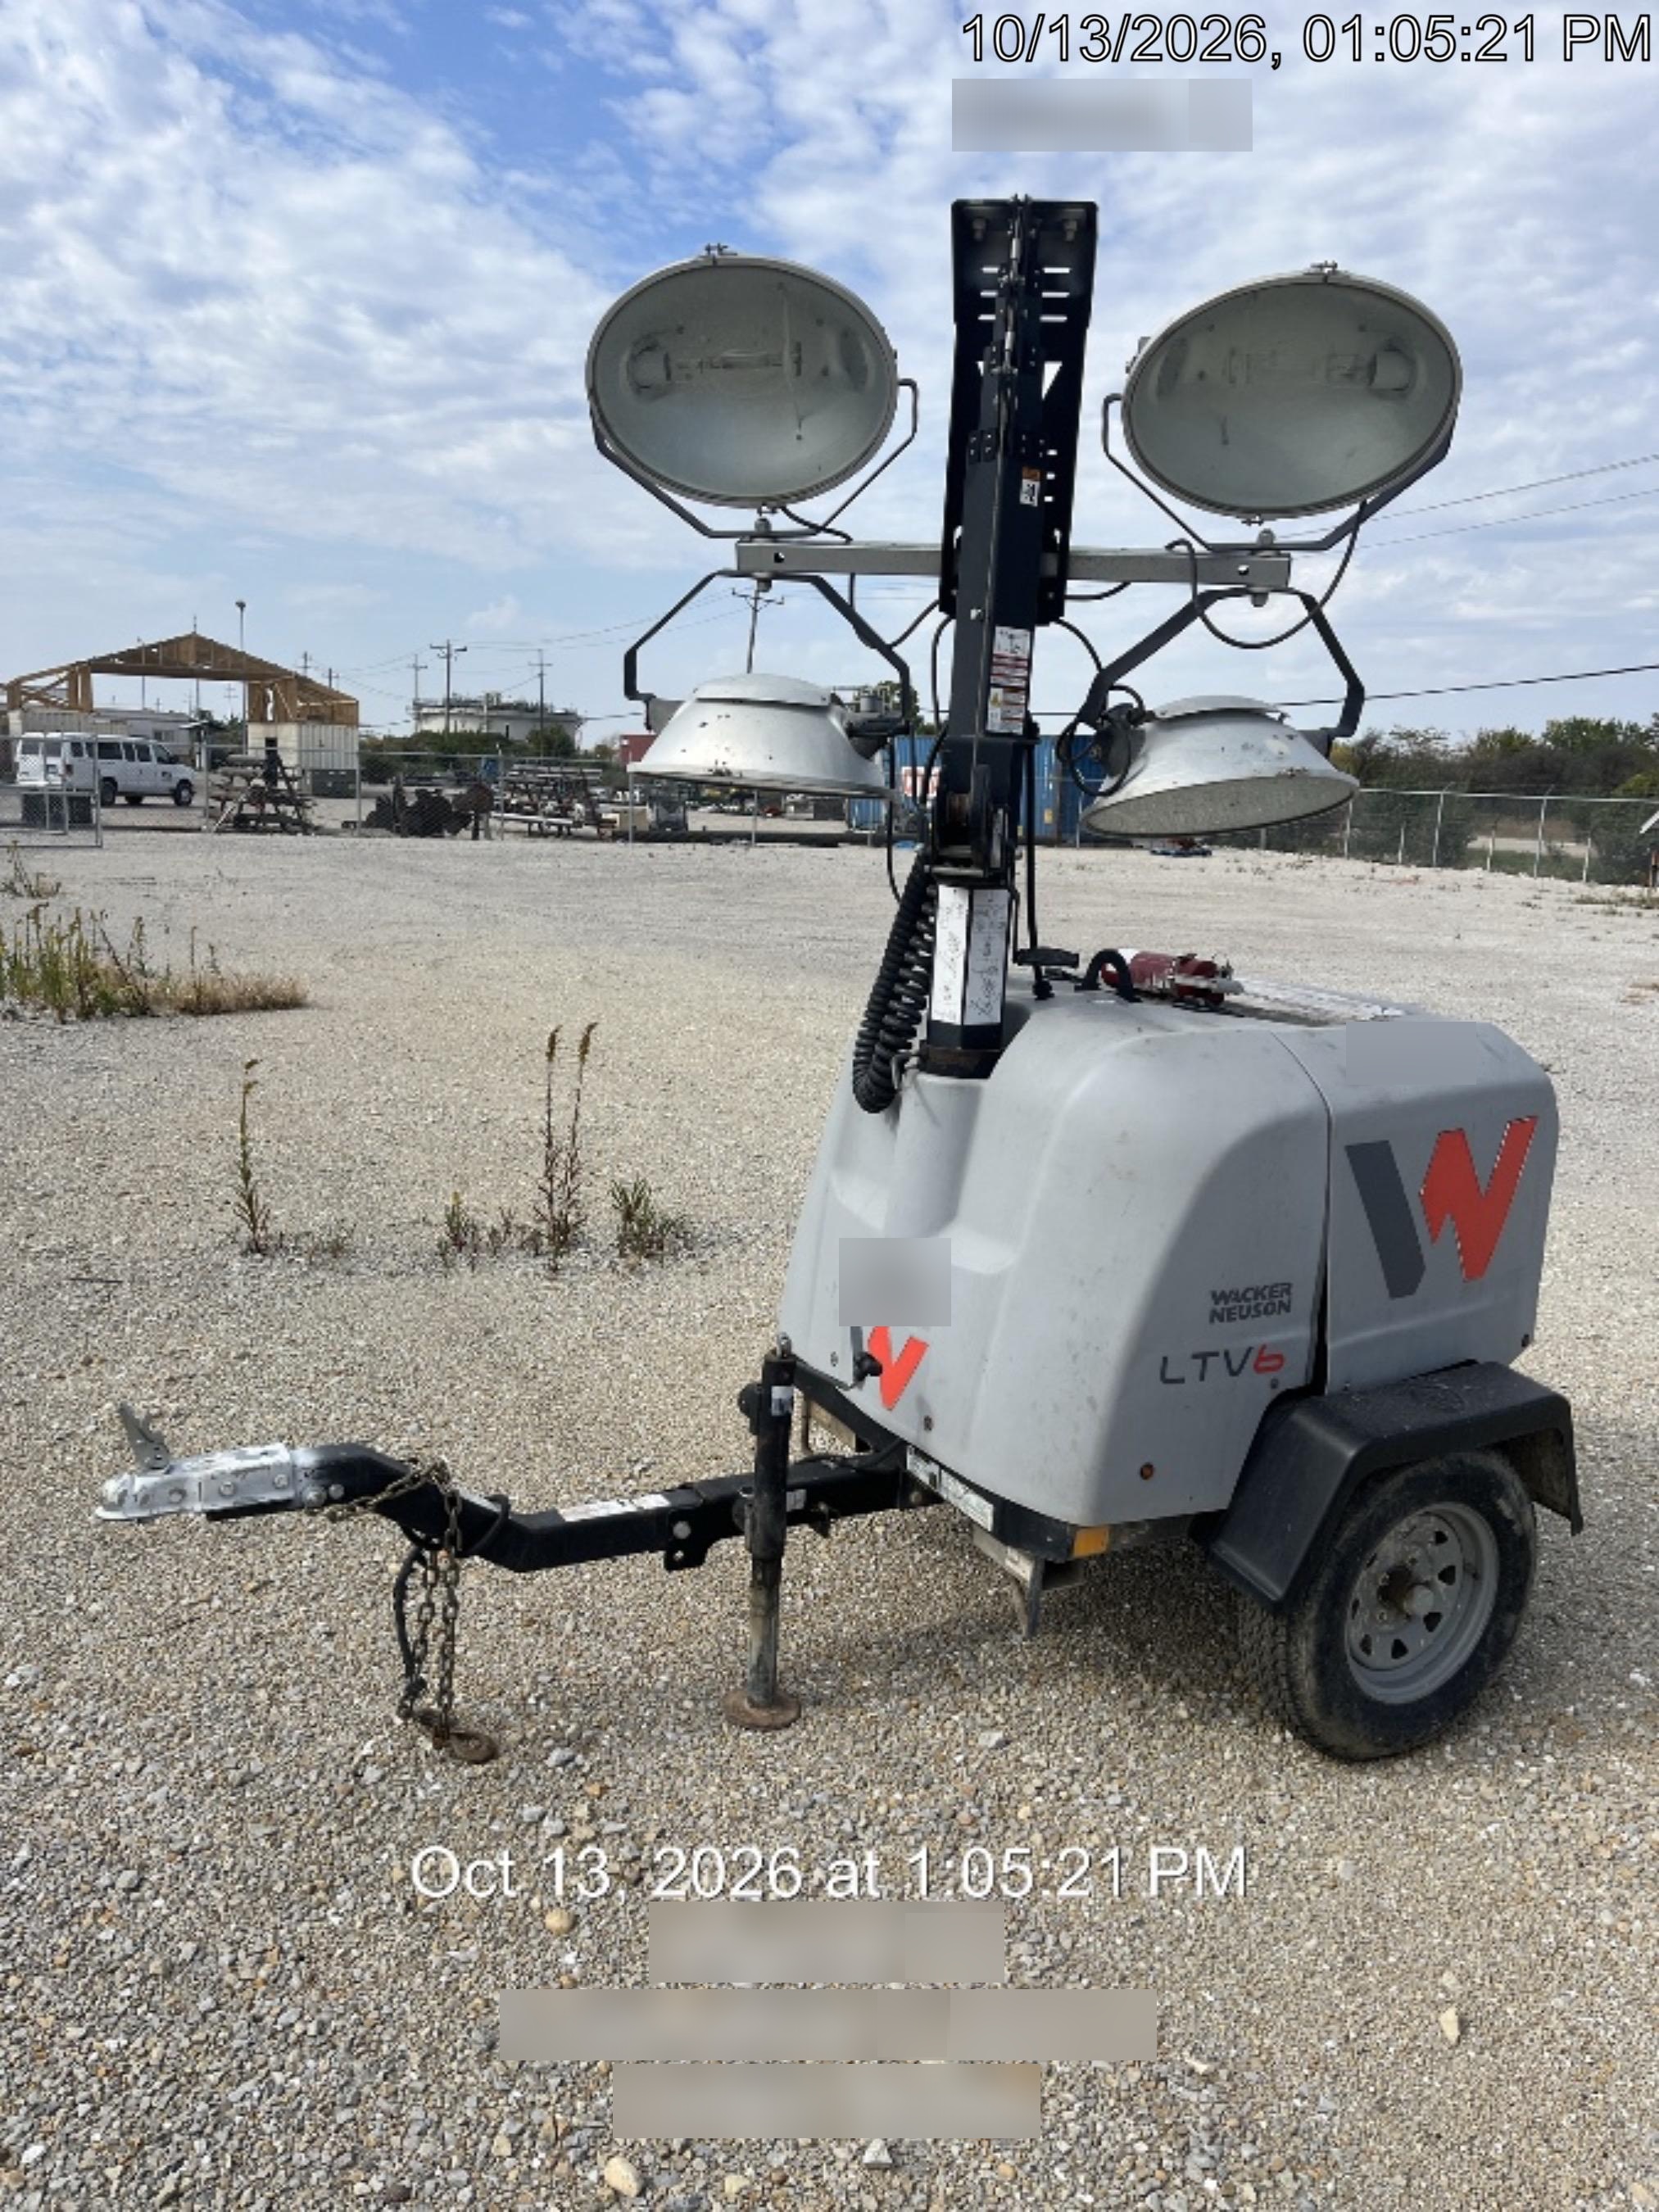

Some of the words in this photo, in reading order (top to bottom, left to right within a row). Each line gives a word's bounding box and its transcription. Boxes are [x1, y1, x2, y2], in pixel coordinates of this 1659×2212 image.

[1210, 1282, 1292, 1305] WACKER
[1208, 1300, 1291, 1324] NEUSON
[1159, 1344, 1285, 1384] LTV6
